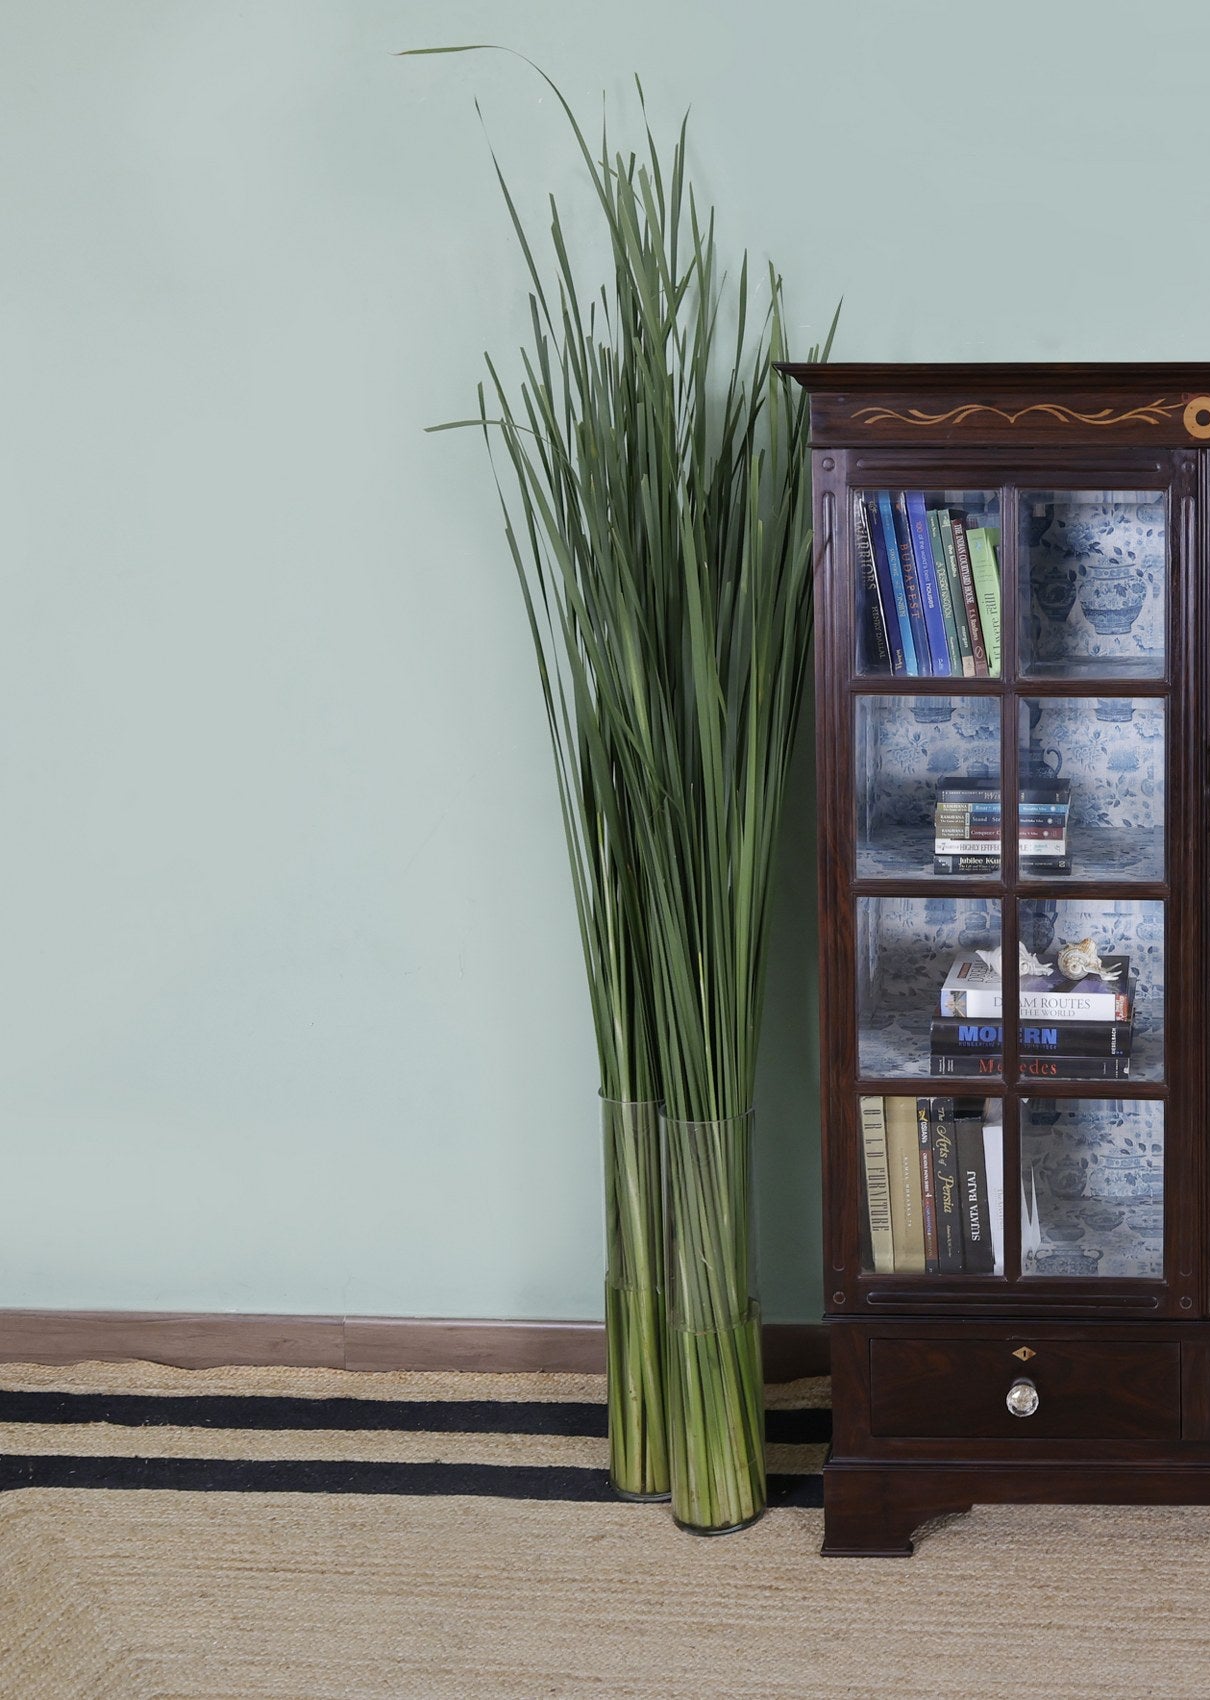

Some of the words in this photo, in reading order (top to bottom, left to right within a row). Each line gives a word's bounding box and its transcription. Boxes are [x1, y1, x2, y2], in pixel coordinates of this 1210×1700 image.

[953, 523, 962, 534] THE
[955, 535, 965, 554] INDIAN
[902, 544, 920, 618] BUDAPEST
[958, 554, 970, 585] COURTYARD
[926, 582, 934, 608] houses
[963, 585, 974, 604] HOUSE
[1041, 998, 1091, 1010] ROUTES
[1042, 1009, 1076, 1017] WORLD
[978, 1059, 1058, 1075] Meedes
[936, 1126, 952, 1159] Arts
[867, 1168, 890, 1232] FURNITURE
[938, 1170, 954, 1214] Persia
[966, 1170, 976, 1202] BAJAJ
[969, 1205, 980, 1242] SUJATA
